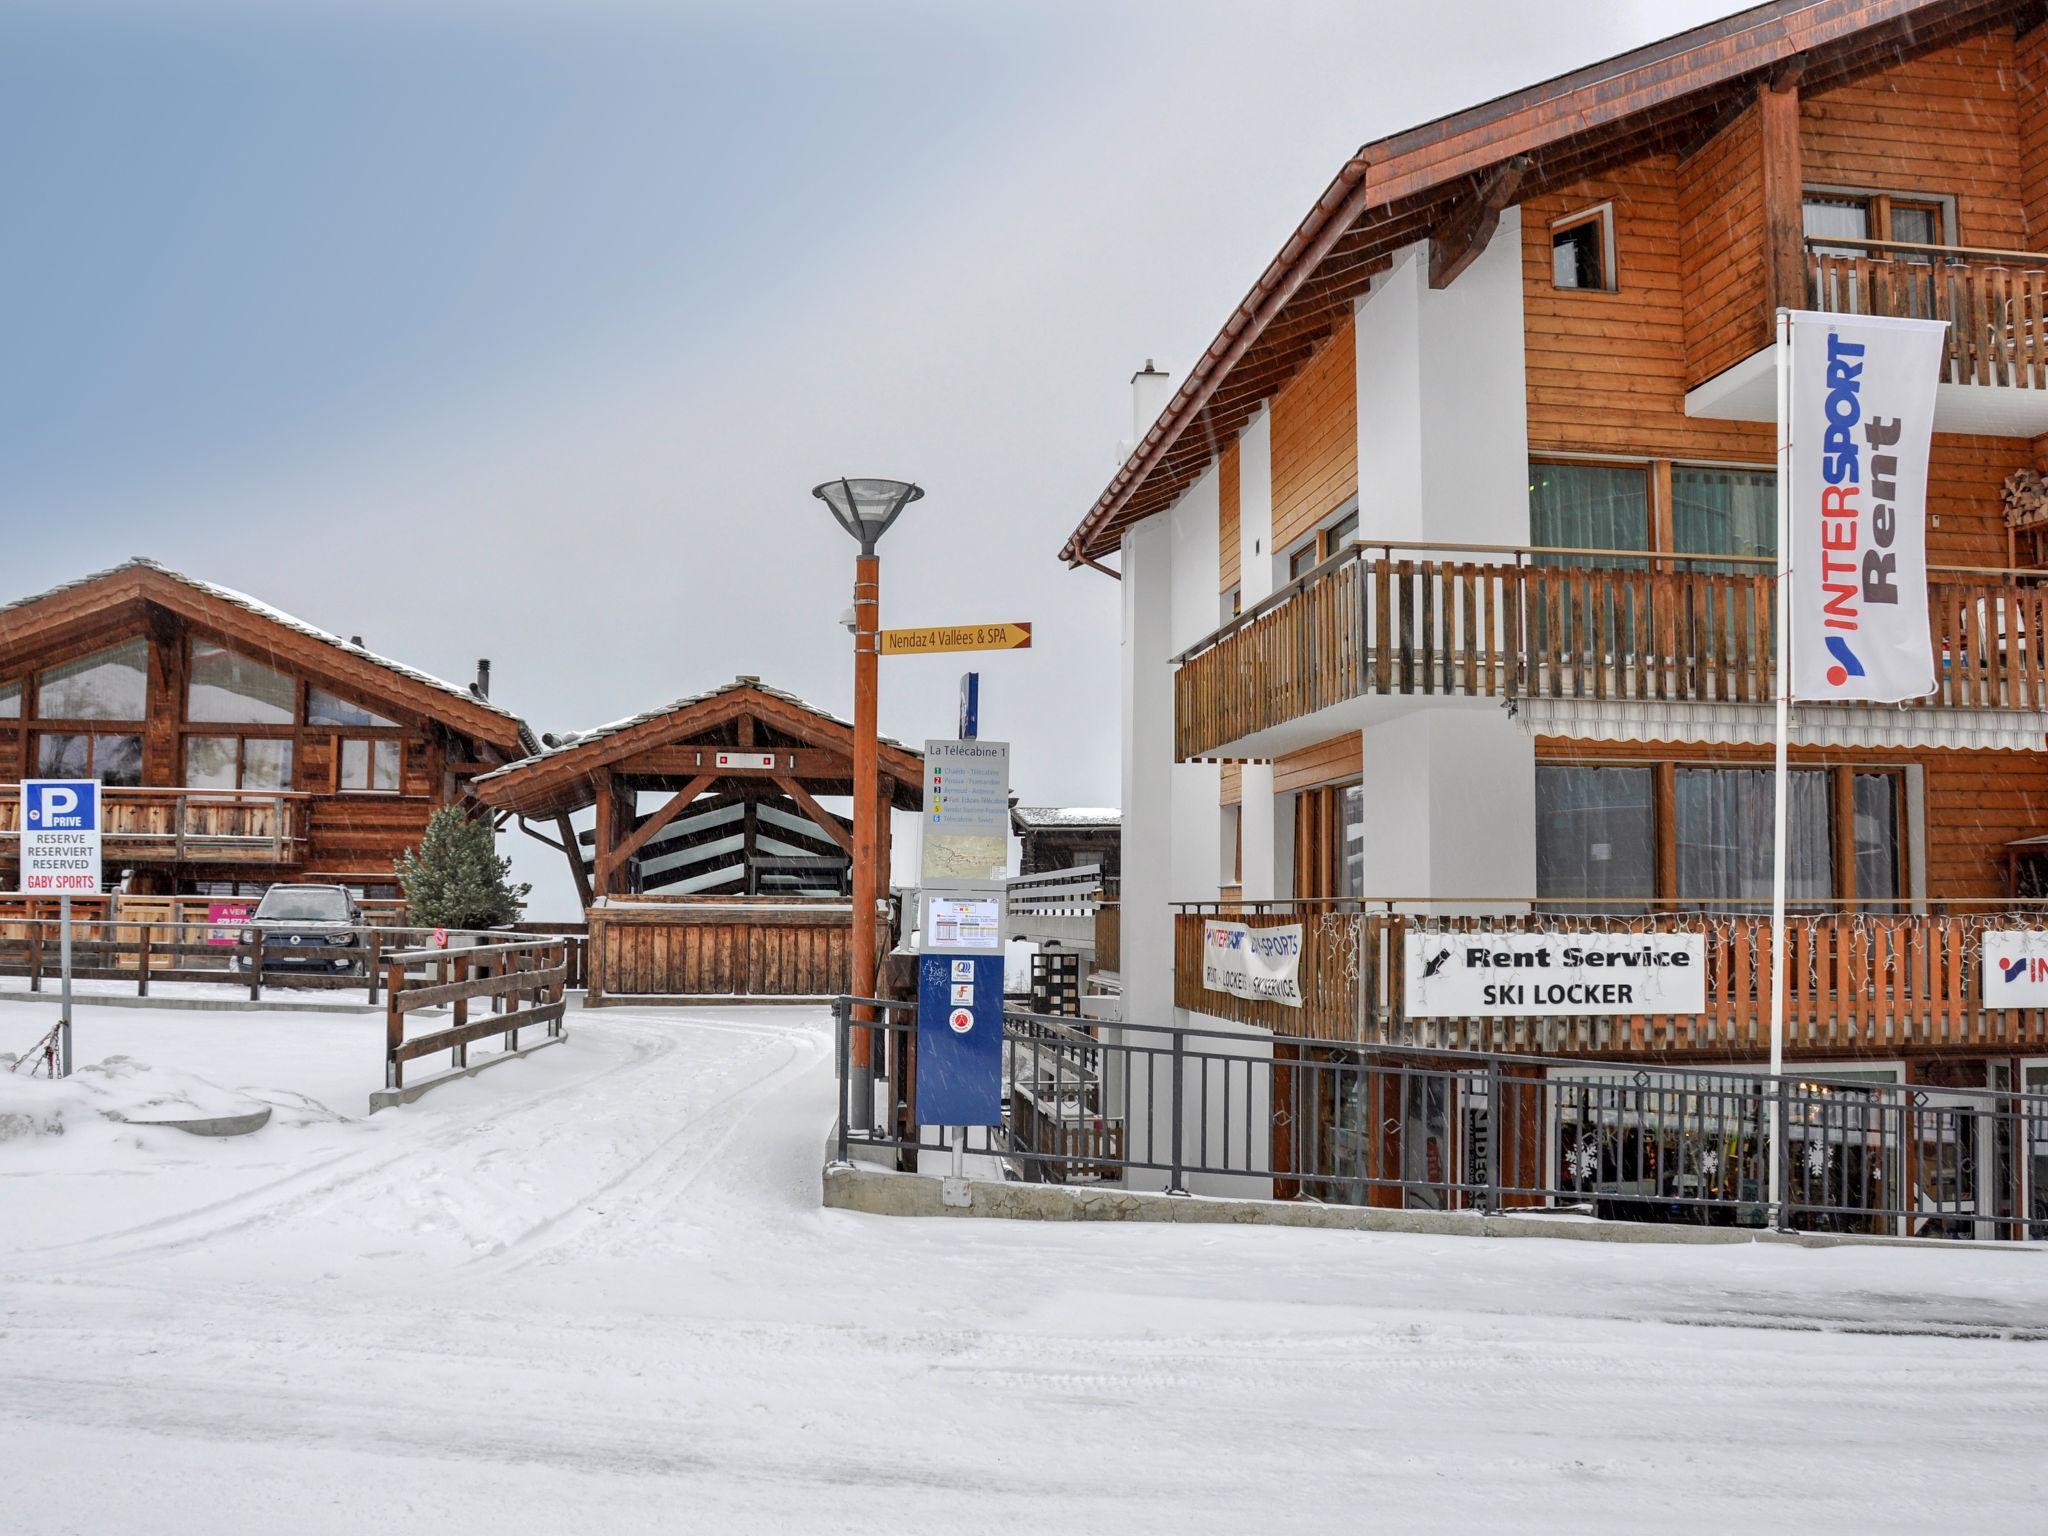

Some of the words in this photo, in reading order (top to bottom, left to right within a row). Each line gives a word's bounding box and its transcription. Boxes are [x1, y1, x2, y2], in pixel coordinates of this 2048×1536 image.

[1821, 333, 1866, 631] INTERSPORT
[1862, 415, 1902, 605] Rent
[889, 633, 927, 649] Nendaz
[928, 633, 935, 646] 4
[938, 630, 974, 647] Vallées
[976, 630, 985, 644] &
[987, 628, 1007, 644] SPA
[930, 745, 941, 755] La
[944, 745, 998, 757] Télécabine
[1001, 748, 1006, 757] 1
[41, 787, 79, 828] P
[53, 816, 82, 827] PRIVE
[37, 834, 86, 844] RESERVE
[28, 847, 94, 857] RESERVIERT
[33, 859, 89, 869] RESERVED
[28, 875, 53, 889] GABY
[56, 875, 95, 889] SPORTS
[229, 908, 248, 916] VEN
[1466, 947, 1550, 968] Rent
[1562, 946, 1690, 968] Service
[1483, 984, 1524, 1005] SKI
[1534, 983, 1634, 1005] LOCKER
